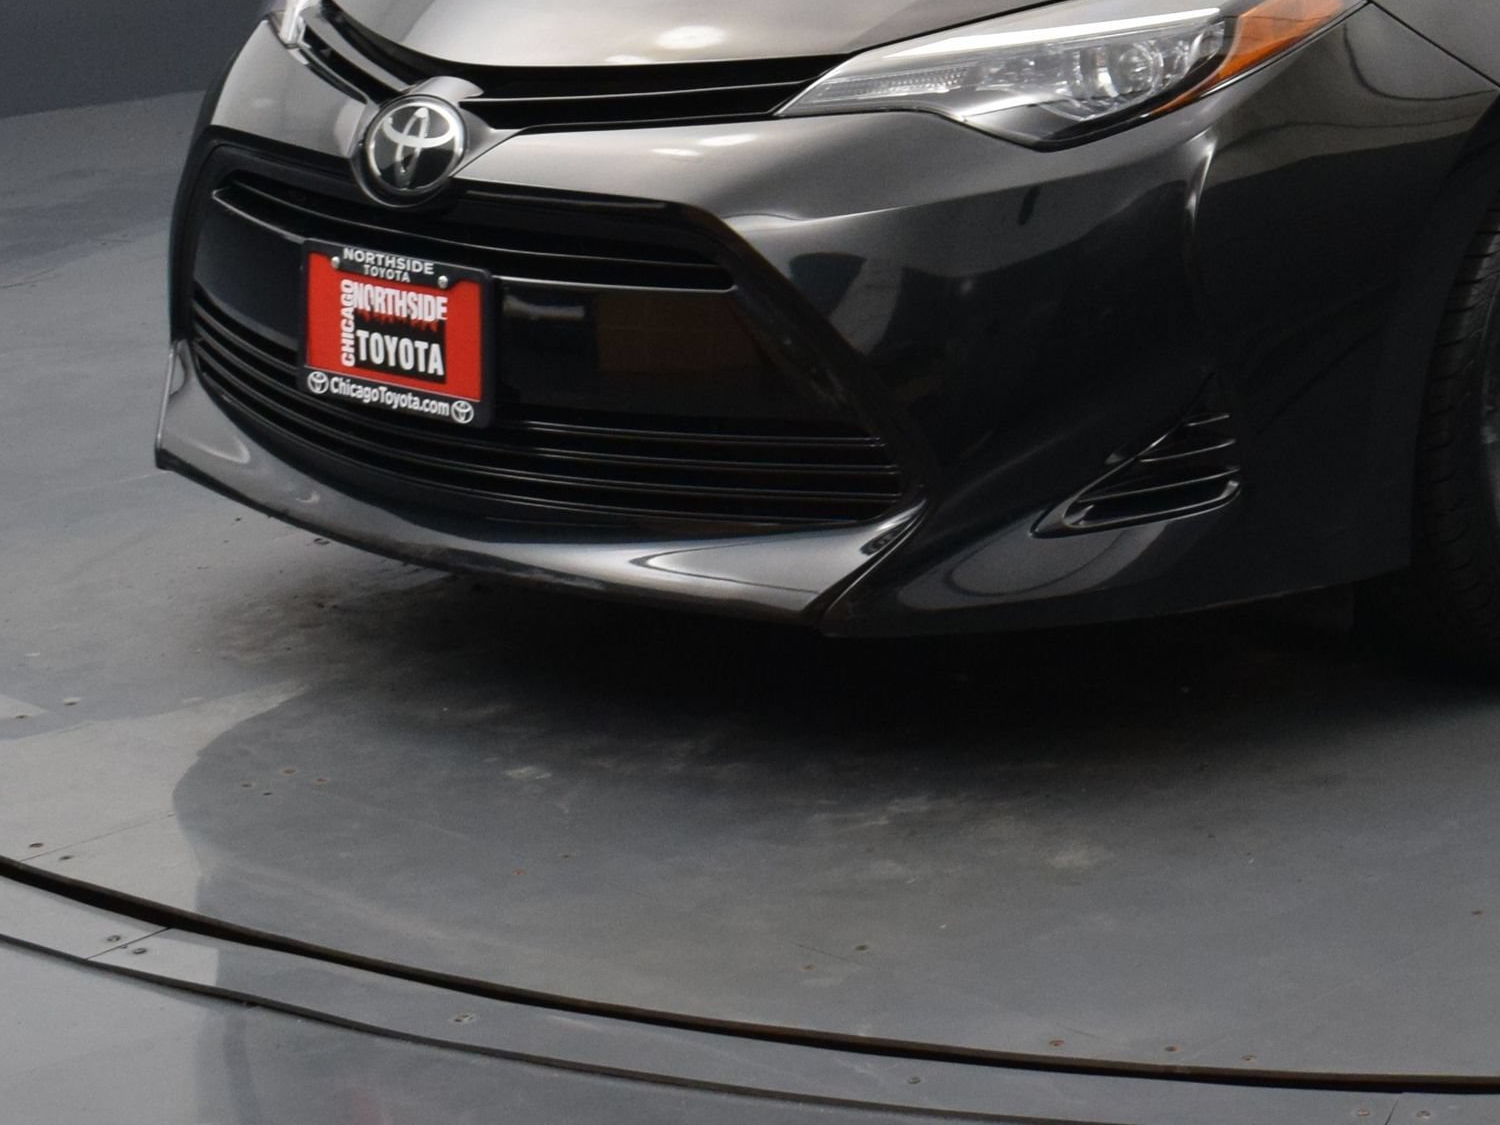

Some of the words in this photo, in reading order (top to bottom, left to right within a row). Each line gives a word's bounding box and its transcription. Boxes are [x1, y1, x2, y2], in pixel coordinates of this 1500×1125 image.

[343, 248, 435, 275] NORTHSIDE
[363, 264, 411, 283] TOYOTA
[353, 281, 448, 322] NORTHSIDE
[340, 279, 356, 367] CHICAGO
[355, 329, 445, 375] TOYOTA
[330, 376, 450, 416] ChicagoToyota.com
